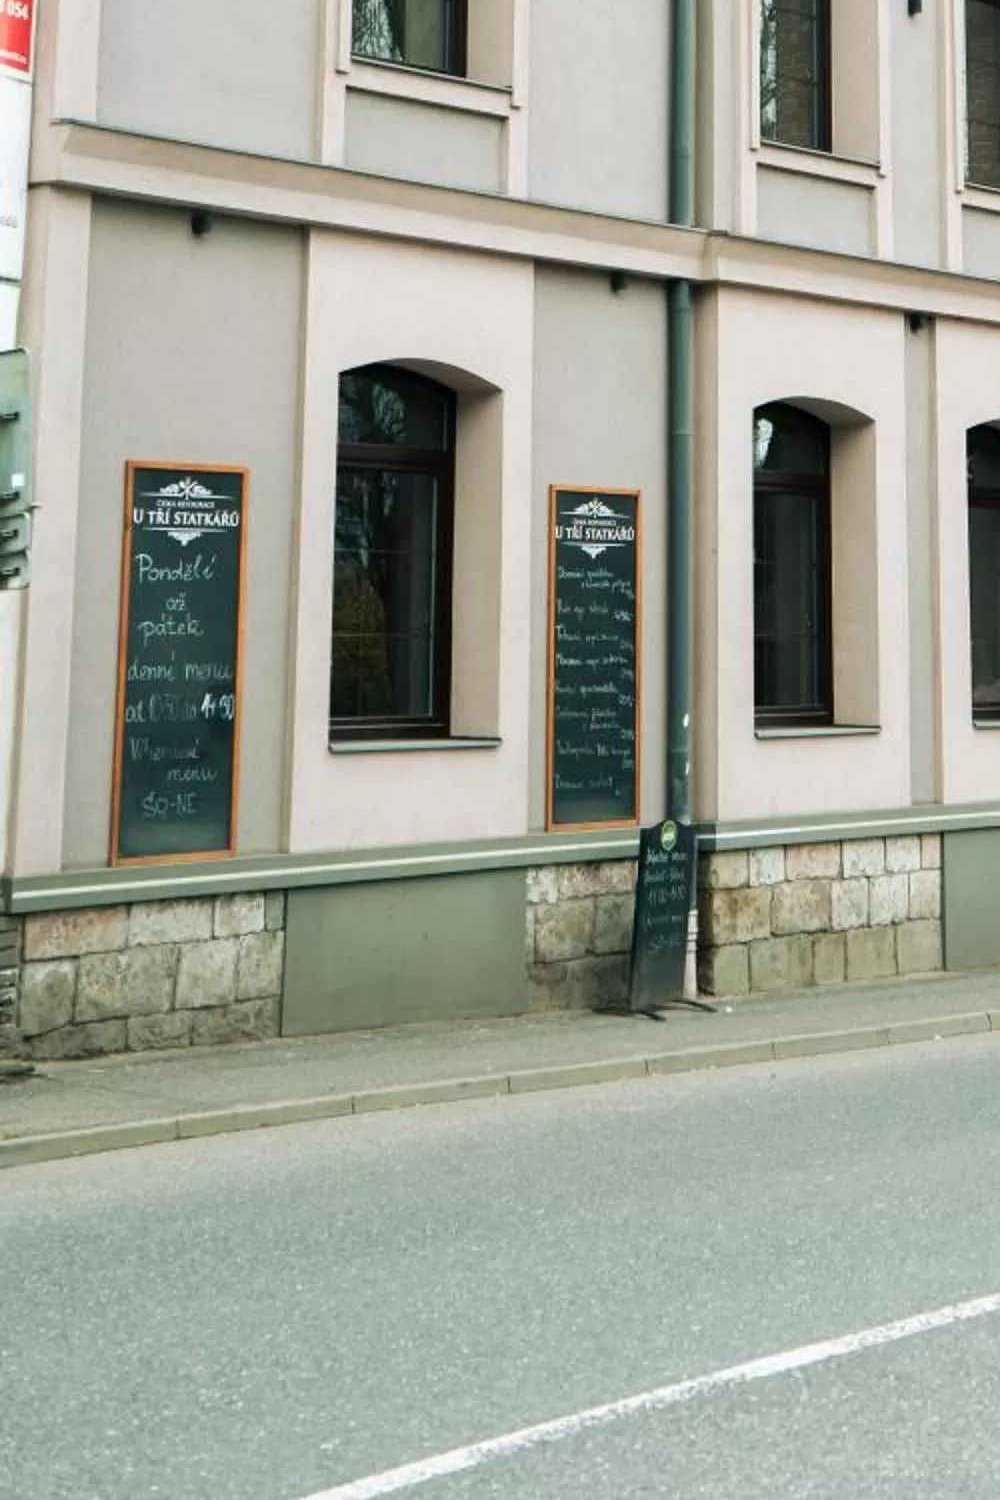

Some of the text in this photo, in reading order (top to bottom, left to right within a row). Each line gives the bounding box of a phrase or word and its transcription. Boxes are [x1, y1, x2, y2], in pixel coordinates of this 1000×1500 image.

[133, 507, 240, 527] U TŘÍ STATKÁŘŮ
[555, 525, 563, 539] U
[135, 553, 217, 584] Pondělí
[185, 663, 232, 681] menu
[166, 766, 218, 782] menu
